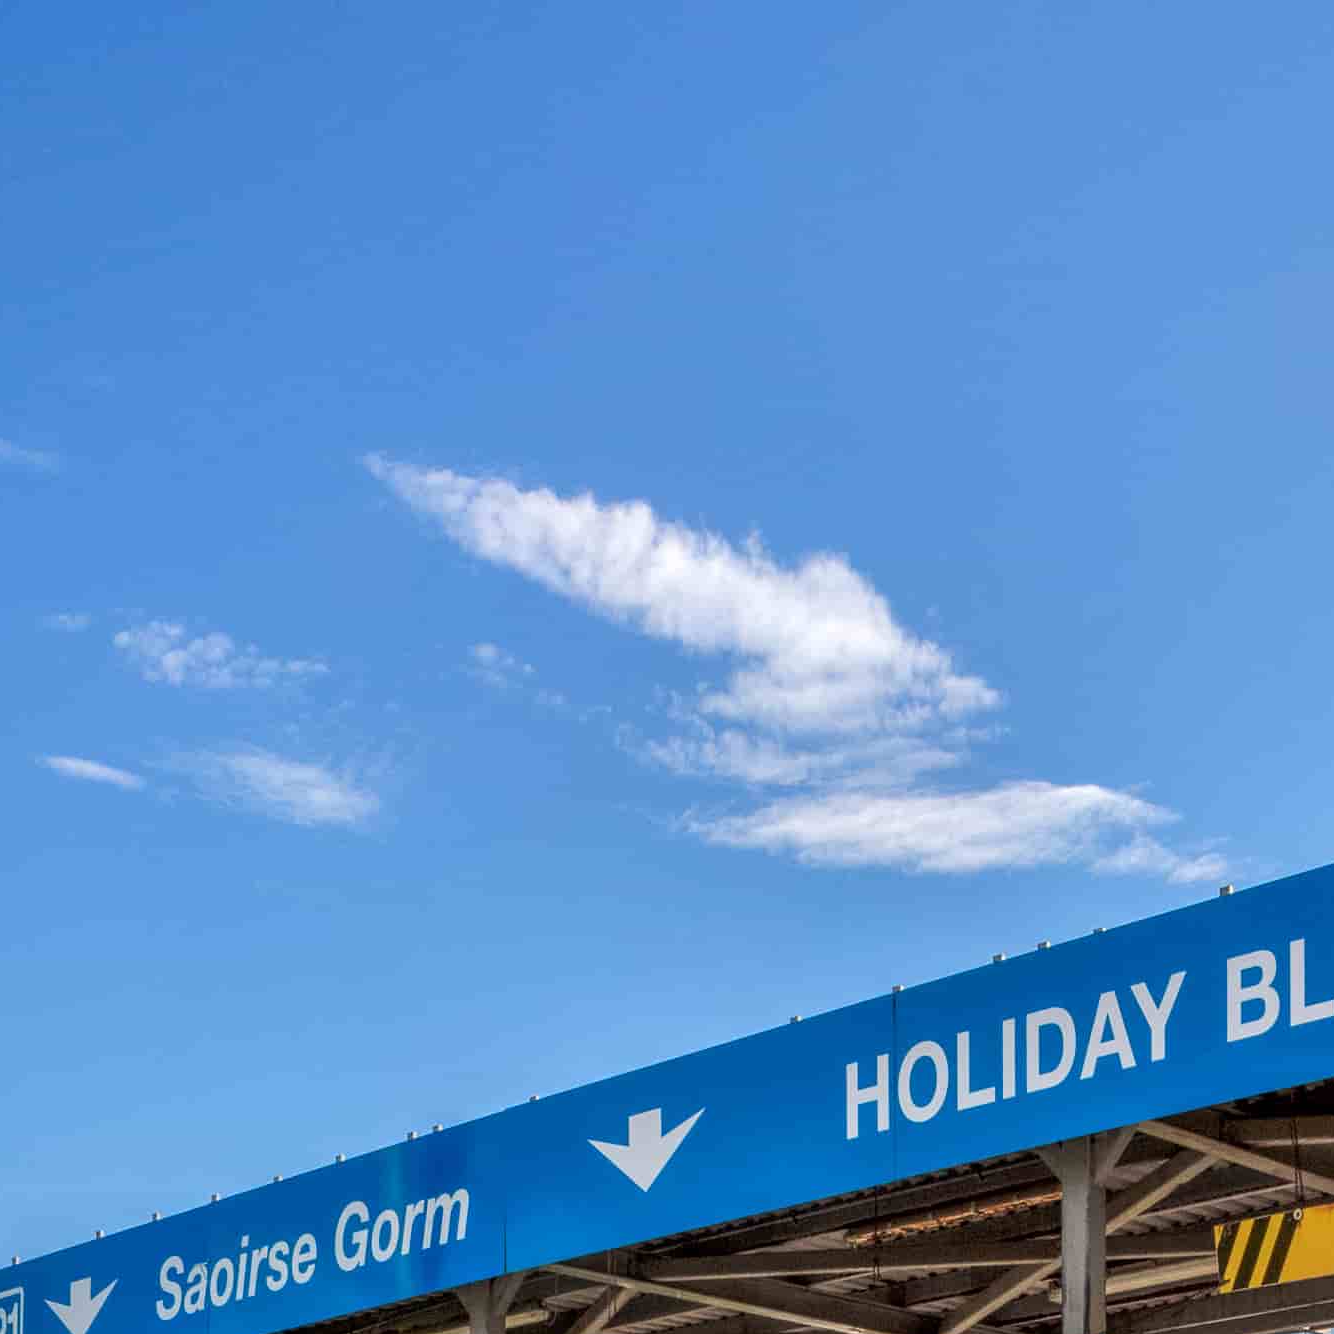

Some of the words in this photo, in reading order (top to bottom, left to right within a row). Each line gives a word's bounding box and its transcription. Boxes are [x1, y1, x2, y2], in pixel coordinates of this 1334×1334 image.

[845, 970, 1188, 1141] HOLIDAY
[155, 1233, 318, 1321] Saoirse
[334, 1187, 470, 1273] Gorm
